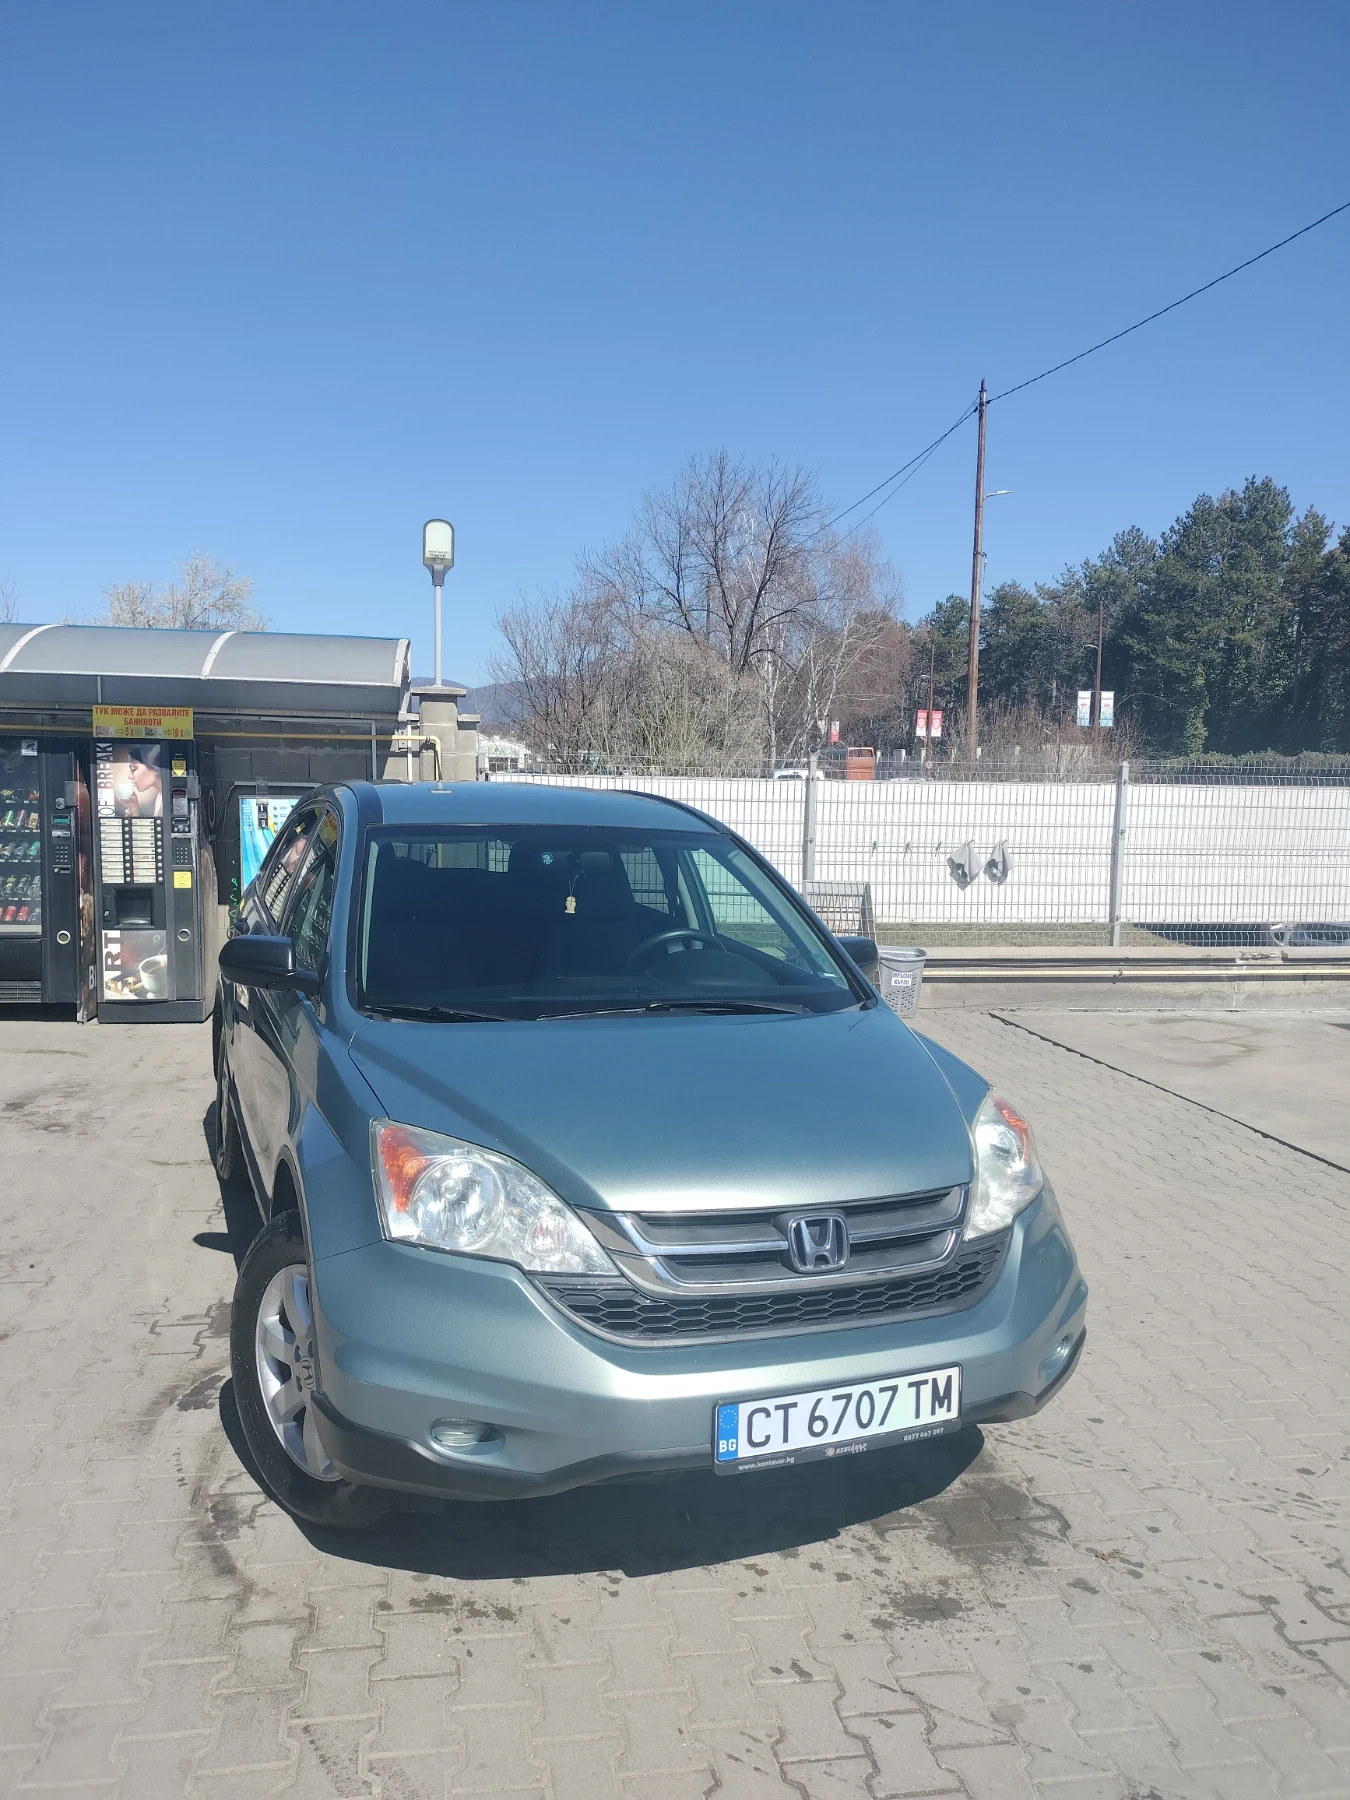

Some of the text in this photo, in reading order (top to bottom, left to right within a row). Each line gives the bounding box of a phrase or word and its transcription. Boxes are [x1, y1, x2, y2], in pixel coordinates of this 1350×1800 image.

[95, 707, 190, 717] ТУК МОЖЕ ДА РАЗВАЛИТЕ
[124, 717, 162, 726] БАНКНОТИ
[125, 727, 129, 736] 5
[747, 1374, 953, 1449] CT 6707 TM
[903, 1433, 919, 1441] 0877
[719, 1438, 737, 1453] BG
